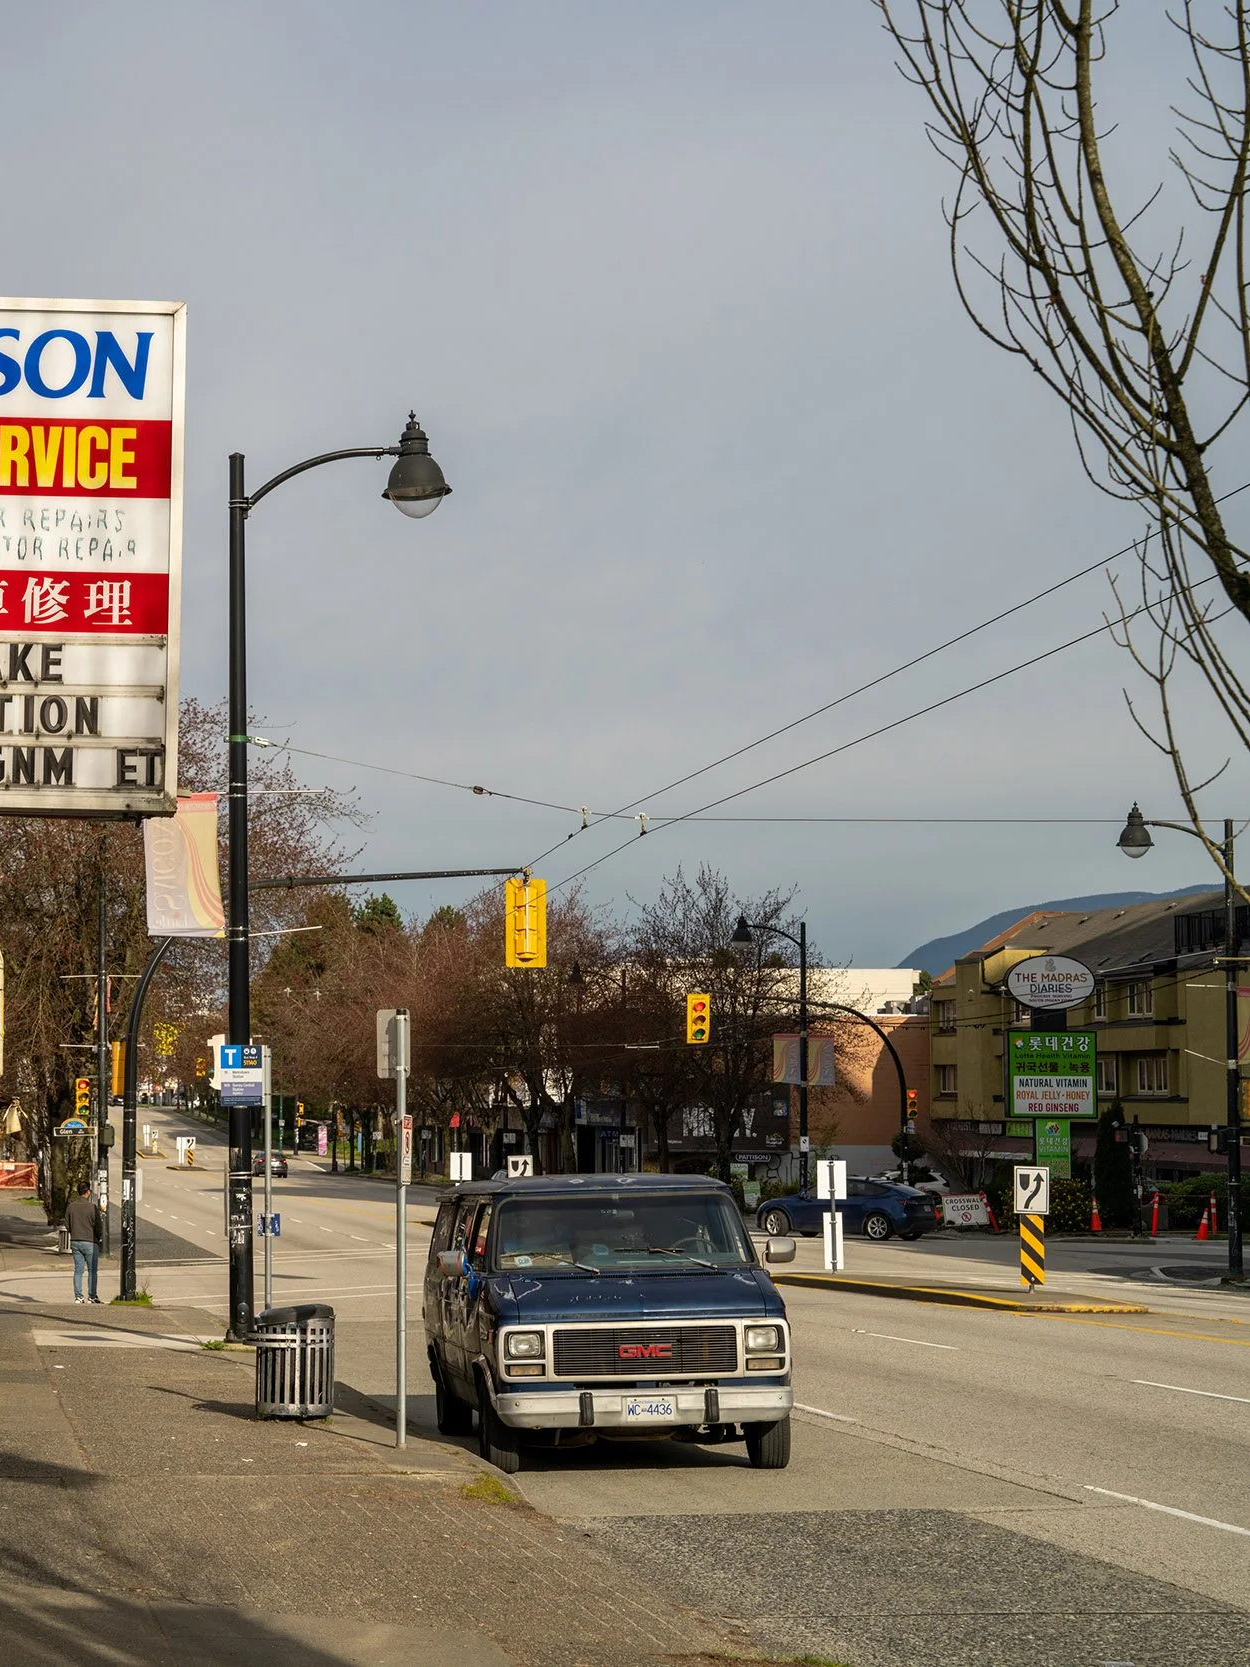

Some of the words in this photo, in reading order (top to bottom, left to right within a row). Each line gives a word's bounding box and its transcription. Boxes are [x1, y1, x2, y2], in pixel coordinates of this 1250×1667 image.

[1015, 973, 1037, 983] THE
[1041, 973, 1088, 983] MADRAS
[1030, 983, 1072, 993] DIARIES
[1029, 1036, 1090, 1052] 롯데건강
[224, 1049, 237, 1065] T
[1019, 1079, 1053, 1087] NATURAL
[1056, 1079, 1087, 1087] VITAMIN
[1016, 1091, 1038, 1100] ROYAL
[1028, 1103, 1043, 1112] RED
[1046, 1103, 1079, 1112] GINSENG
[619, 1344, 672, 1358] GMC
